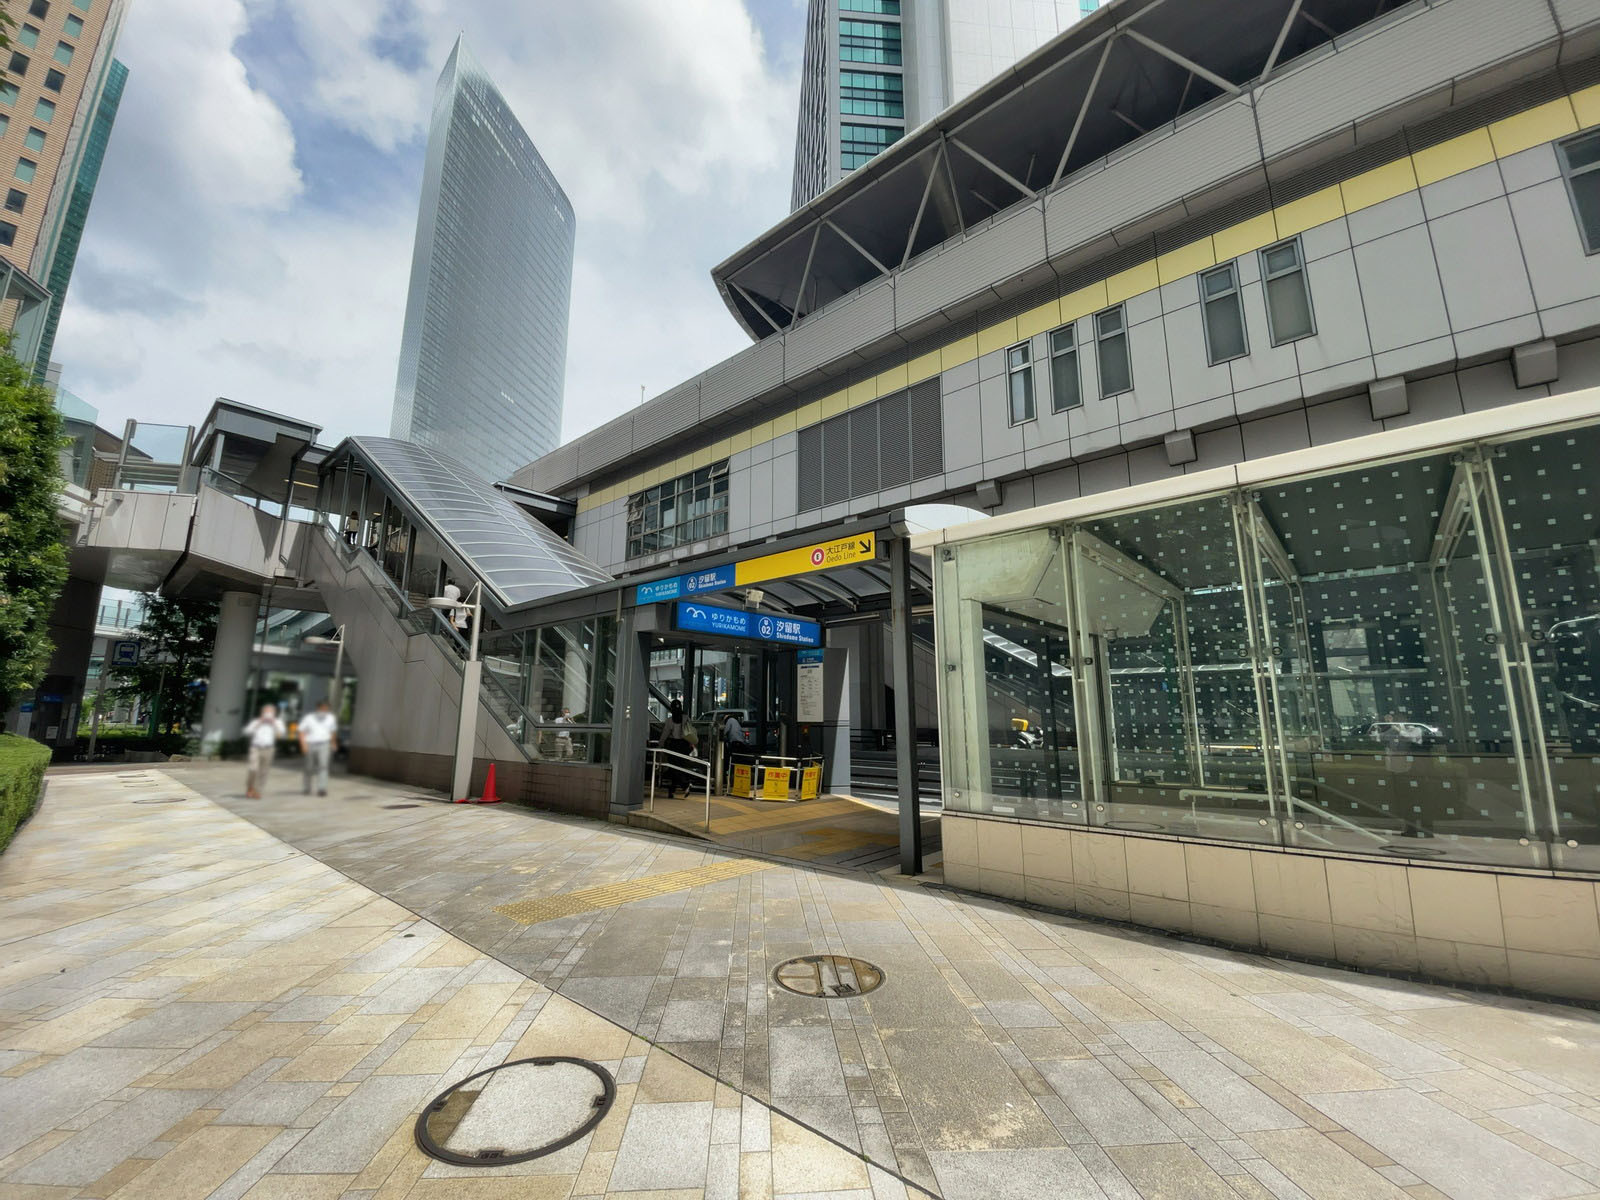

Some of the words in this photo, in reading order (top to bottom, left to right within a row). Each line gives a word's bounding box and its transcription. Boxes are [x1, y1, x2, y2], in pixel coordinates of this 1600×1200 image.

[826, 554, 842, 563] Oedo
[843, 551, 857, 560] Line
[711, 613, 746, 625] ゆりかもめ
[711, 622, 746, 632] YURIKAMOME
[761, 625, 771, 635] 02
[776, 620, 801, 635] 汐留駅
[776, 633, 798, 641] Shiodome
[798, 635, 814, 643] Station
